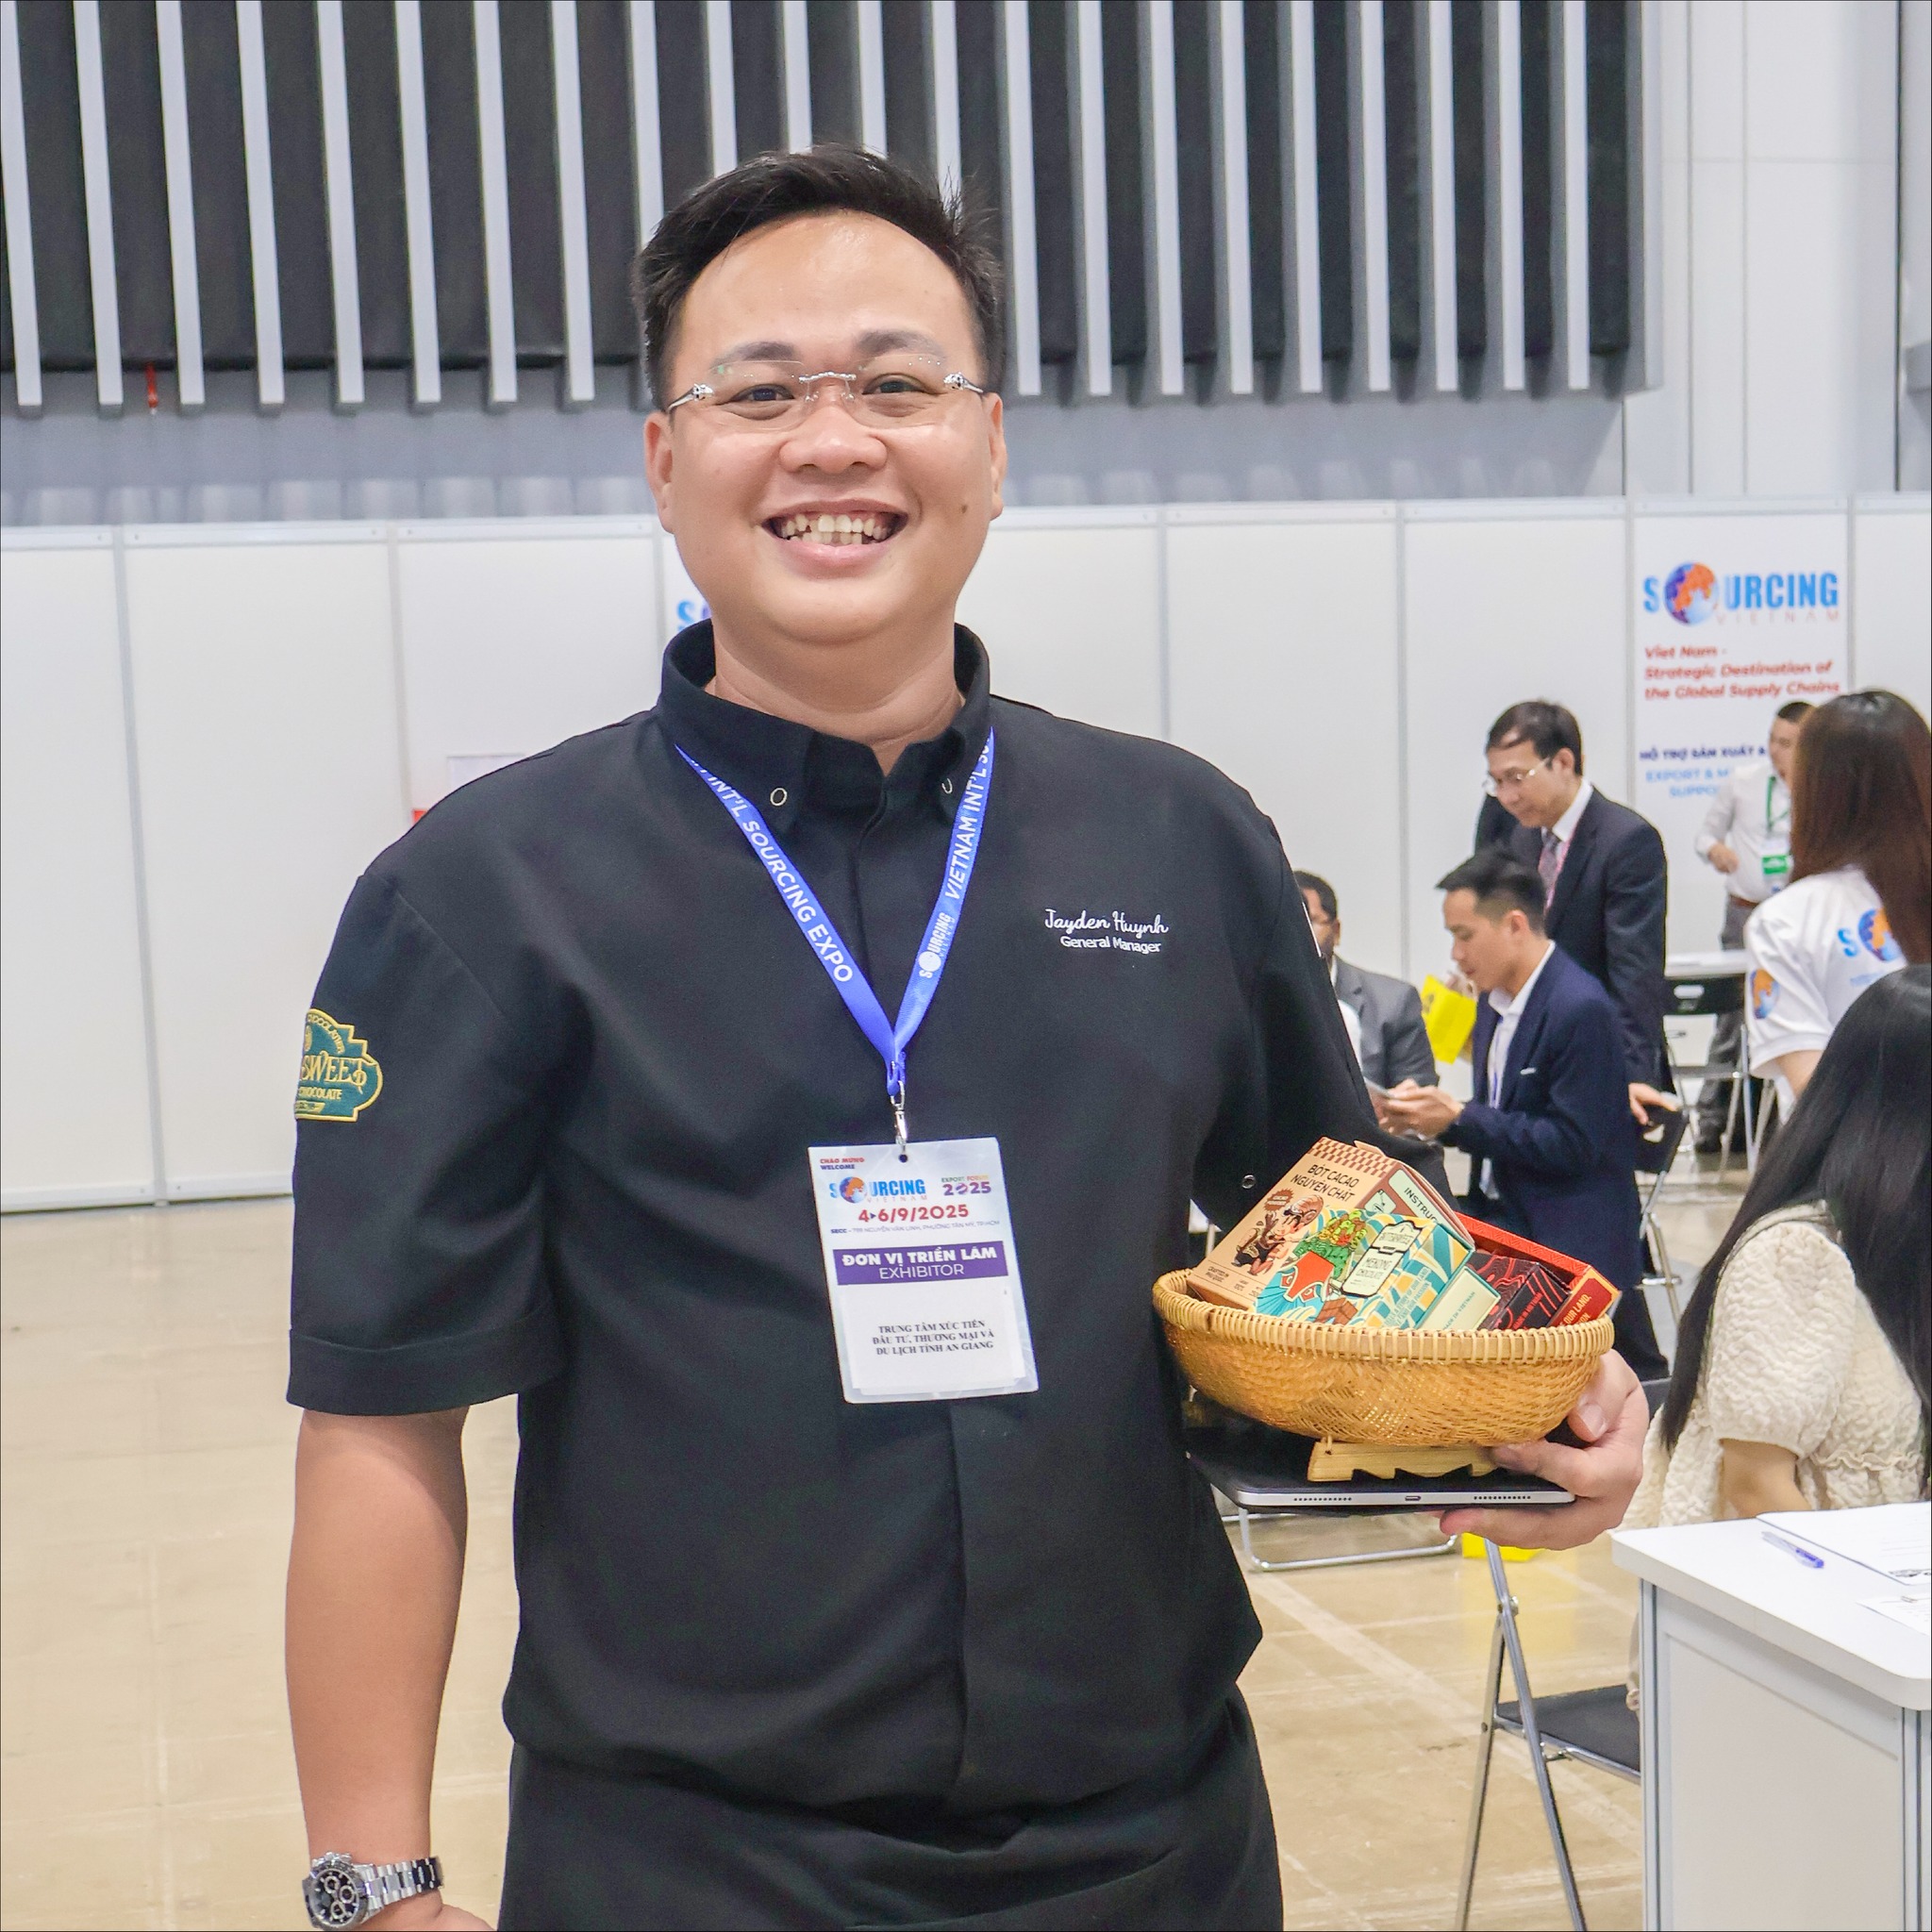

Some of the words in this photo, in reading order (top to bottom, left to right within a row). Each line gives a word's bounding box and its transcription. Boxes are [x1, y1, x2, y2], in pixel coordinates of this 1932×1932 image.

[1645, 644, 1675, 658] Viet
[1679, 646, 1718, 658] Nam
[1645, 663, 1715, 680] Strategic
[1721, 661, 1811, 678] Destination
[1815, 659, 1833, 674] of
[1645, 688, 1670, 700] the
[1675, 685, 1725, 698] Global
[1729, 681, 1782, 700] Supply
[1786, 679, 1840, 694] Chains
[945, 815, 978, 900] VIETNAM
[742, 820, 817, 923] SOURCING
[808, 924, 853, 982] EXPO
[1044, 908, 1111, 934] Jayden
[1112, 910, 1169, 939] Huynh
[1060, 936, 1110, 948] General
[1113, 937, 1161, 954] Manager
[942, 1181, 991, 1196] 2025
[1326, 1171, 1359, 1188] CACAO
[879, 1264, 964, 1279] EXHIBITOR
[1563, 1309, 1578, 1324] OUR
[1573, 1293, 1592, 1313] LAND,
[878, 1324, 912, 1334] TRUNG
[915, 1322, 937, 1332] TÂM
[961, 1341, 993, 1351] GIANG
